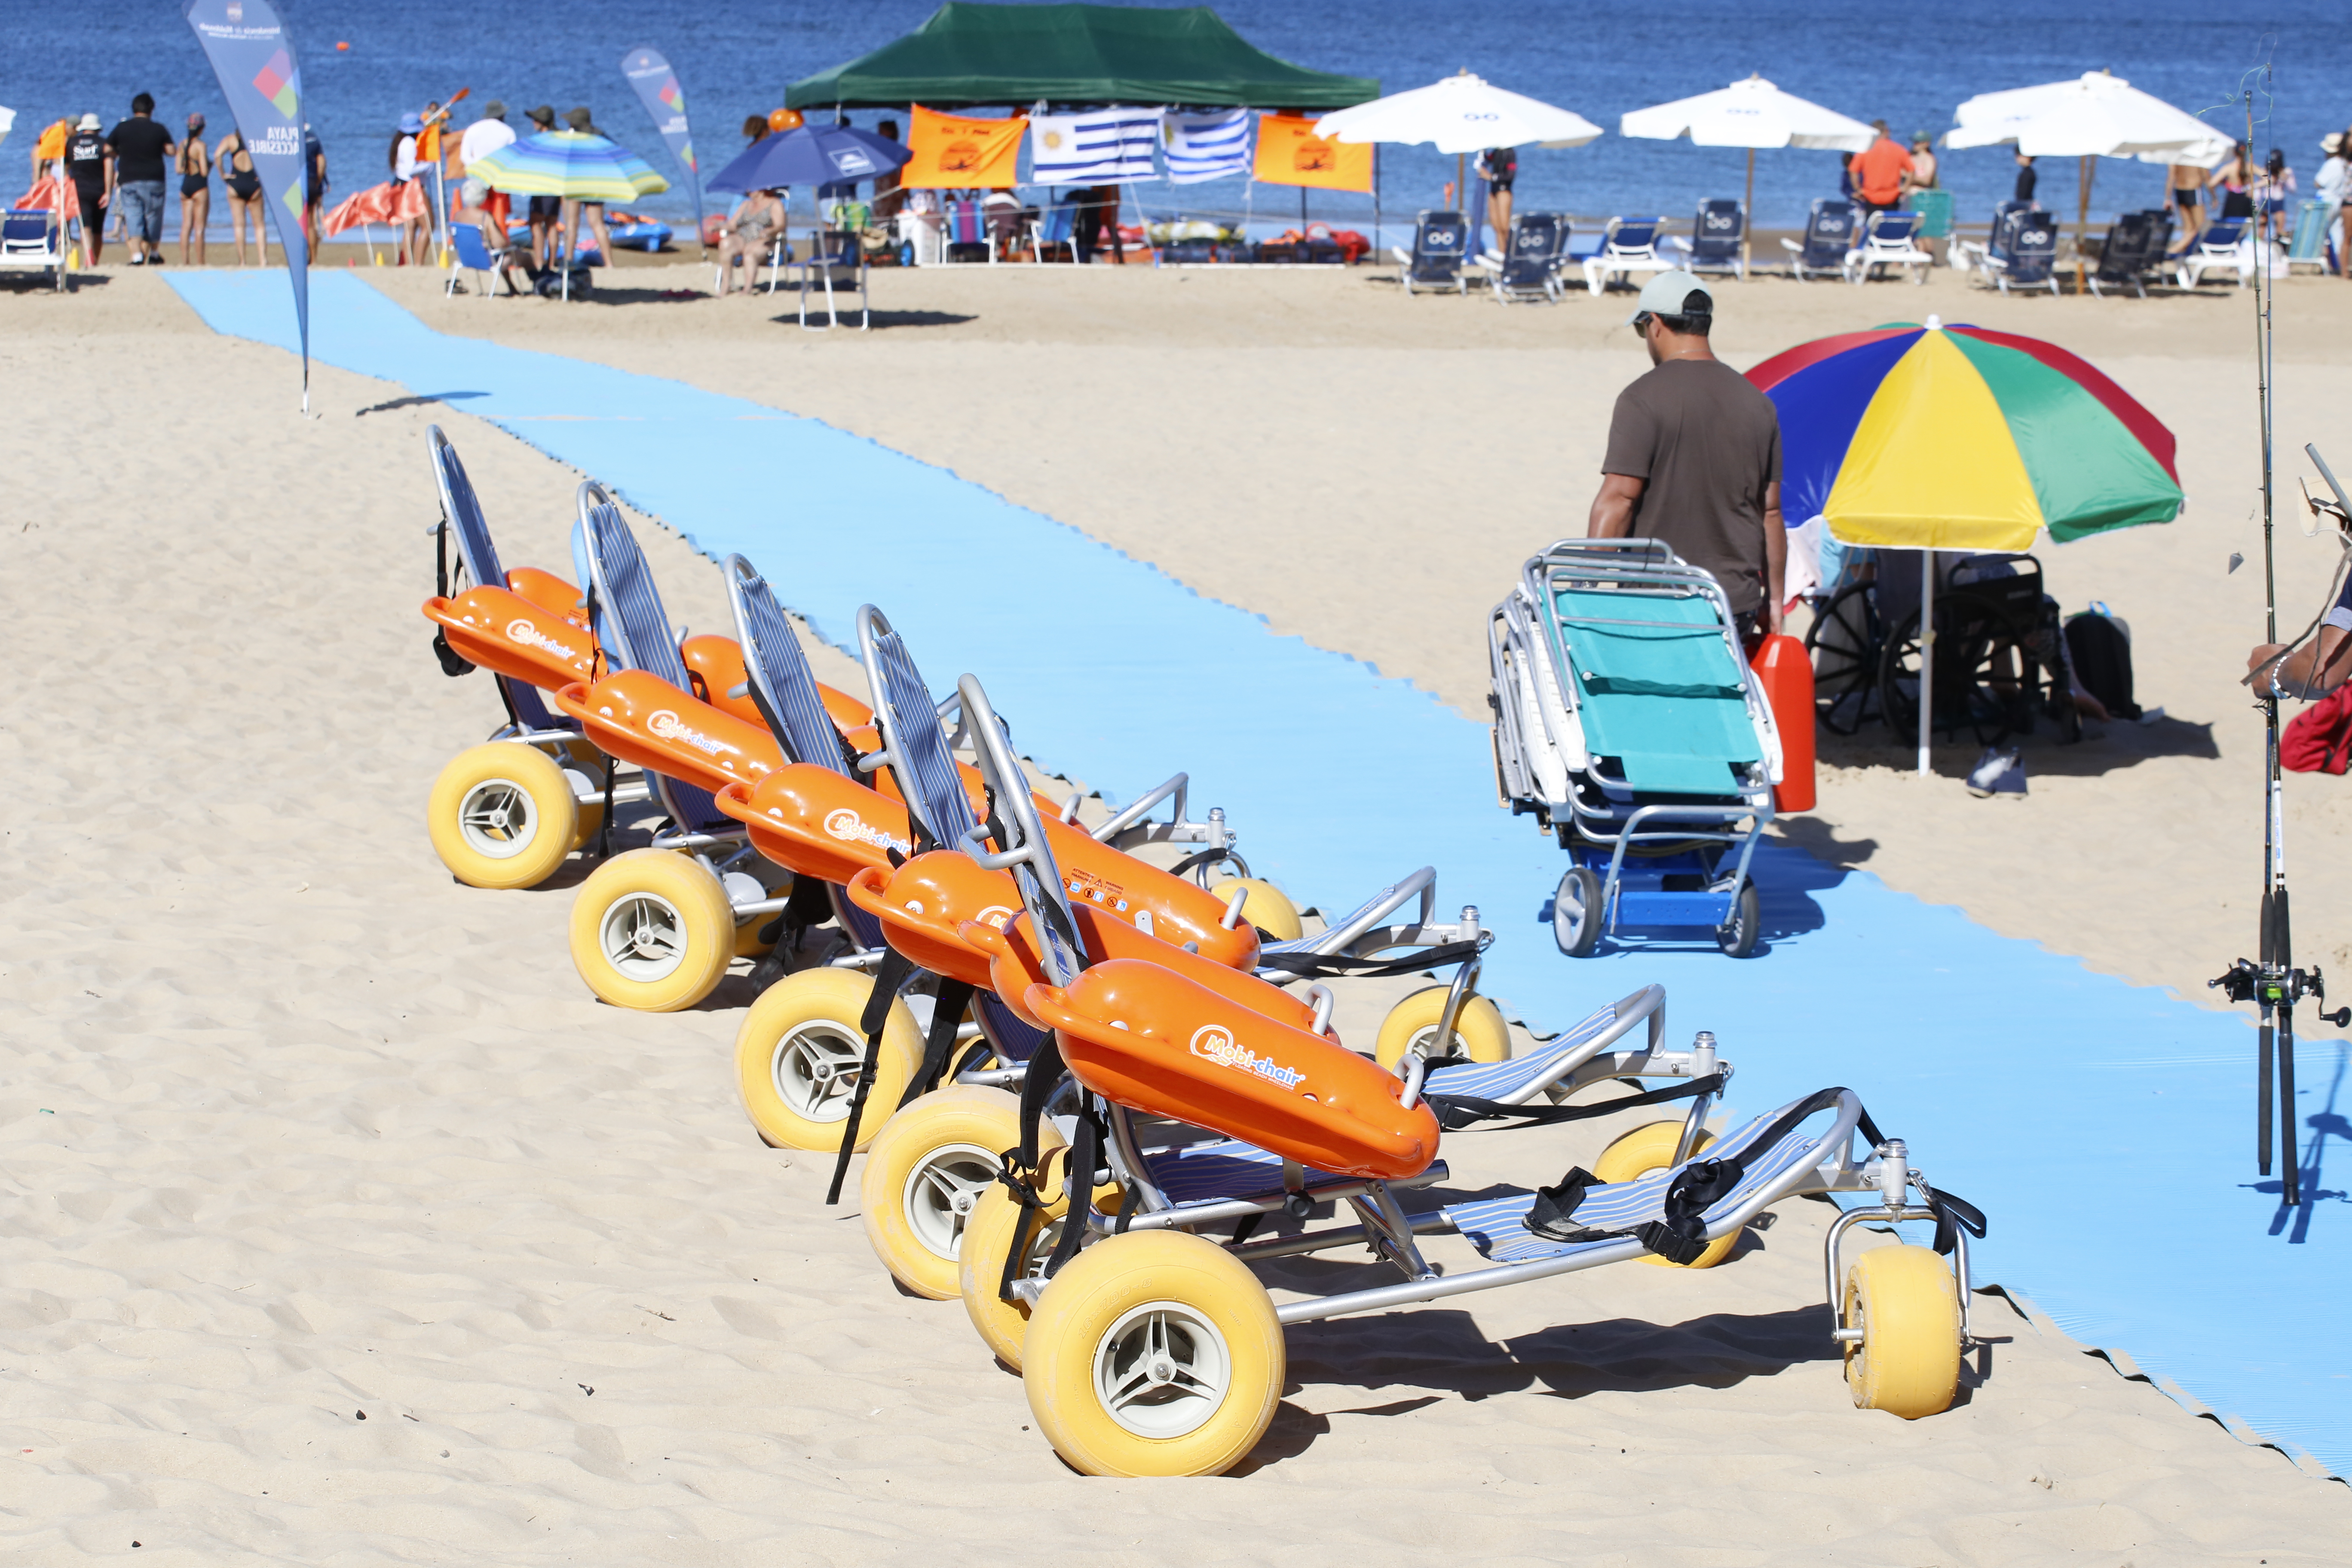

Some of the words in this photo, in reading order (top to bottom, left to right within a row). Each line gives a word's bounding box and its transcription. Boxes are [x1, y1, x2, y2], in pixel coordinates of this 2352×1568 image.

[1072, 868, 1094, 879] ATTENTION
[1105, 886, 1122, 895] CUIDADO
[1106, 881, 1124, 891] WARNING
[1232, 1062, 1253, 1073] FLOATING
[1253, 1071, 1268, 1079] BEACH
[1268, 1077, 1294, 1090] WHEELCHAIR
